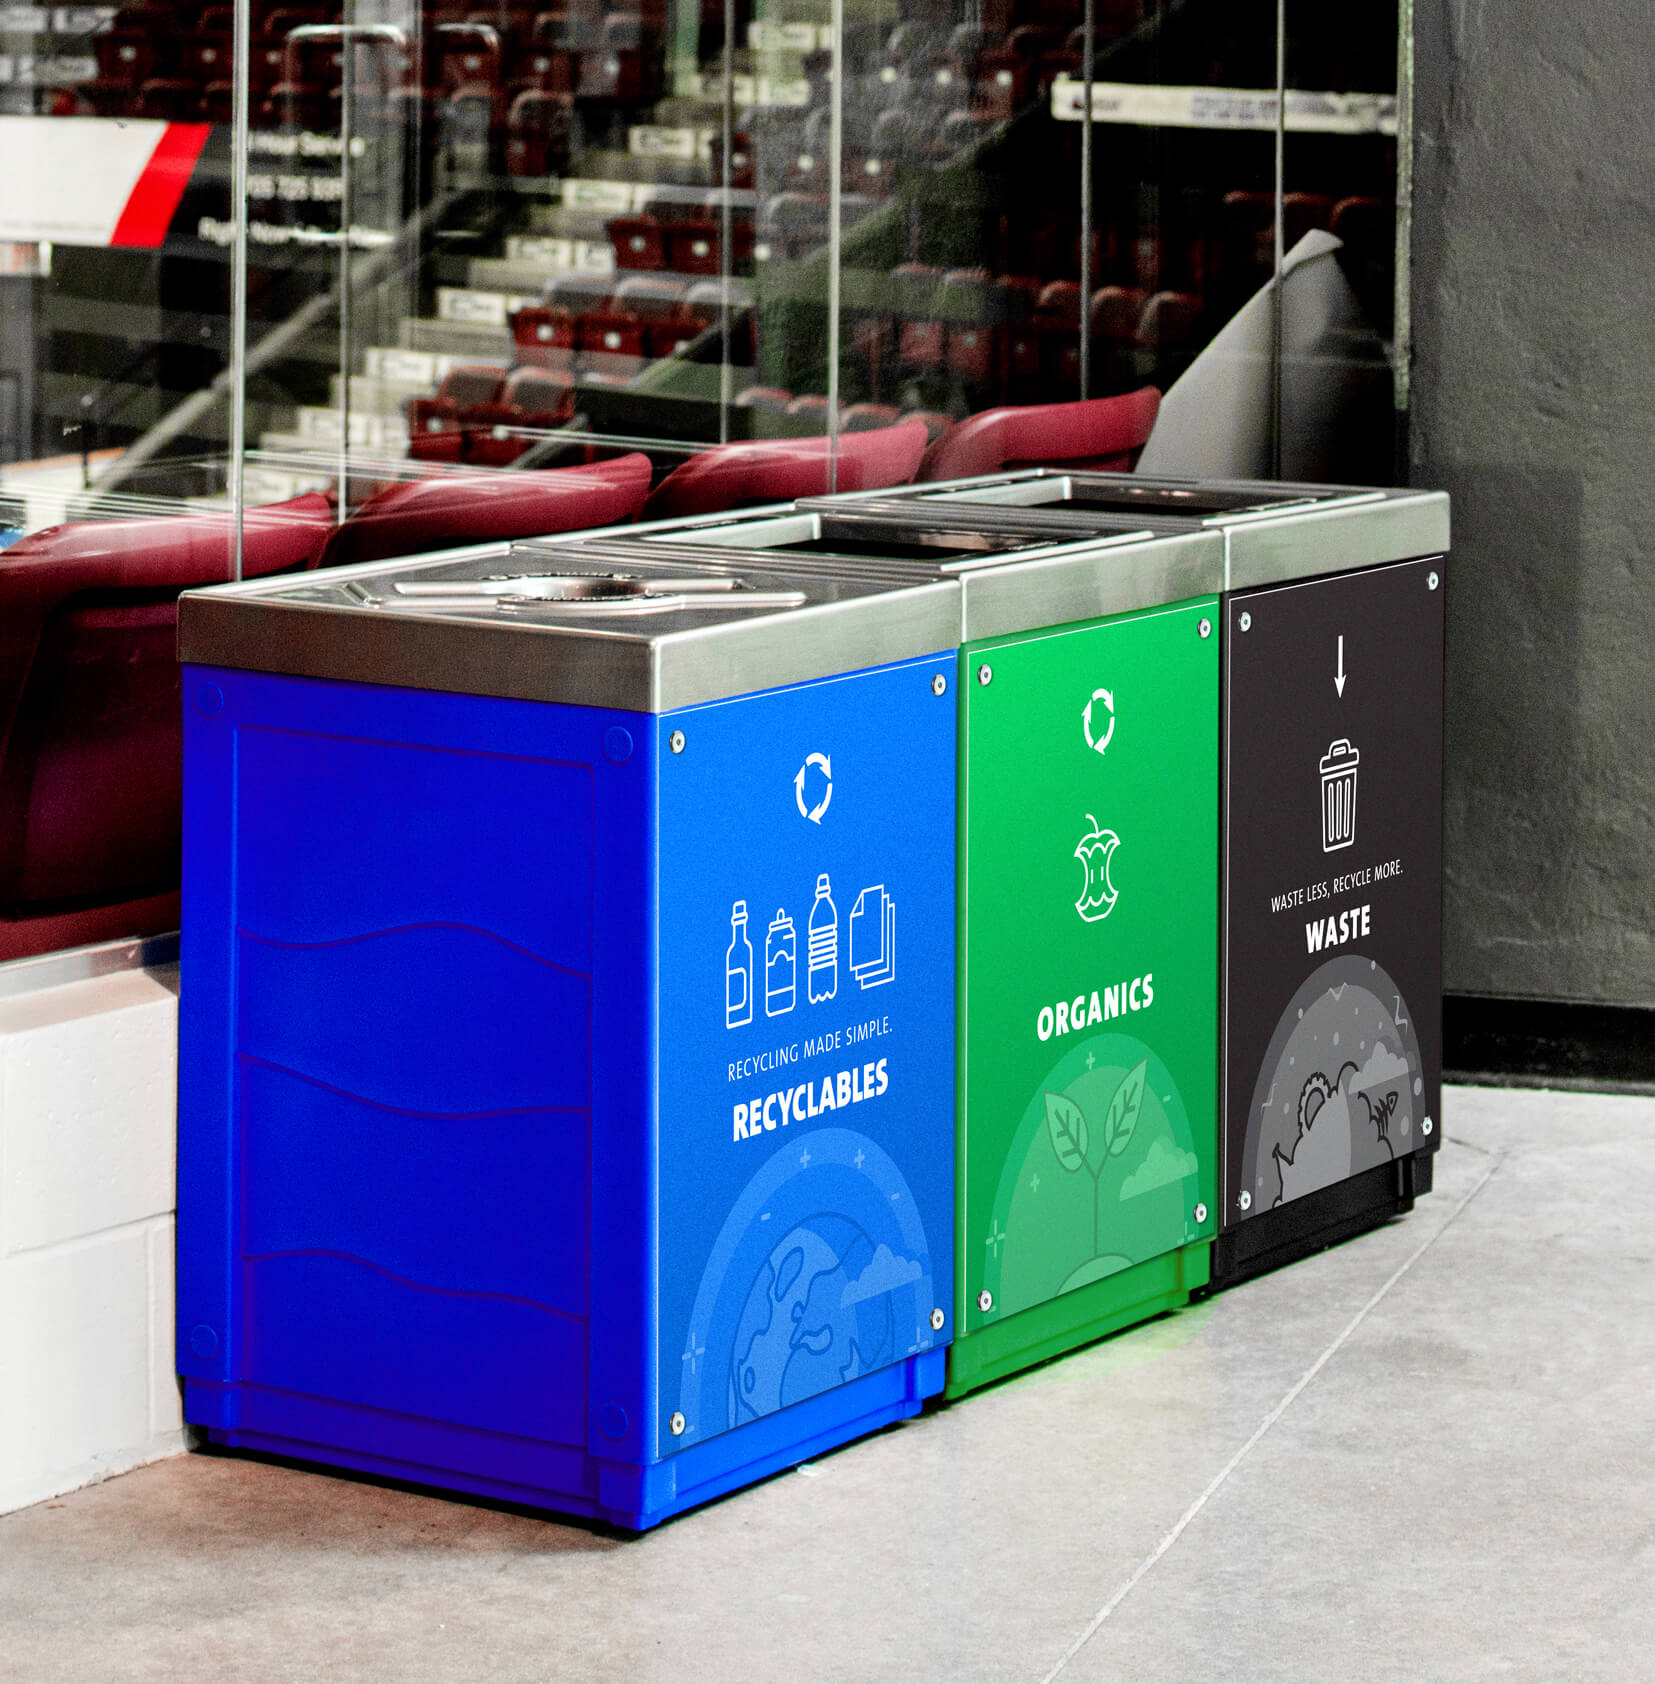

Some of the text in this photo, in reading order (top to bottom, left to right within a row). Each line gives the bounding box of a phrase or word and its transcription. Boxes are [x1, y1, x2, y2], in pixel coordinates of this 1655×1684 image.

[1271, 859, 1403, 913] WASTE LESS, RECYCLE MORE.
[1305, 904, 1371, 954] WASTE
[1036, 973, 1154, 1042] ORGANICS
[728, 1015, 893, 1082] RECYCLING MADE SIMPLE.
[733, 1057, 889, 1142] RECYCLABLES
